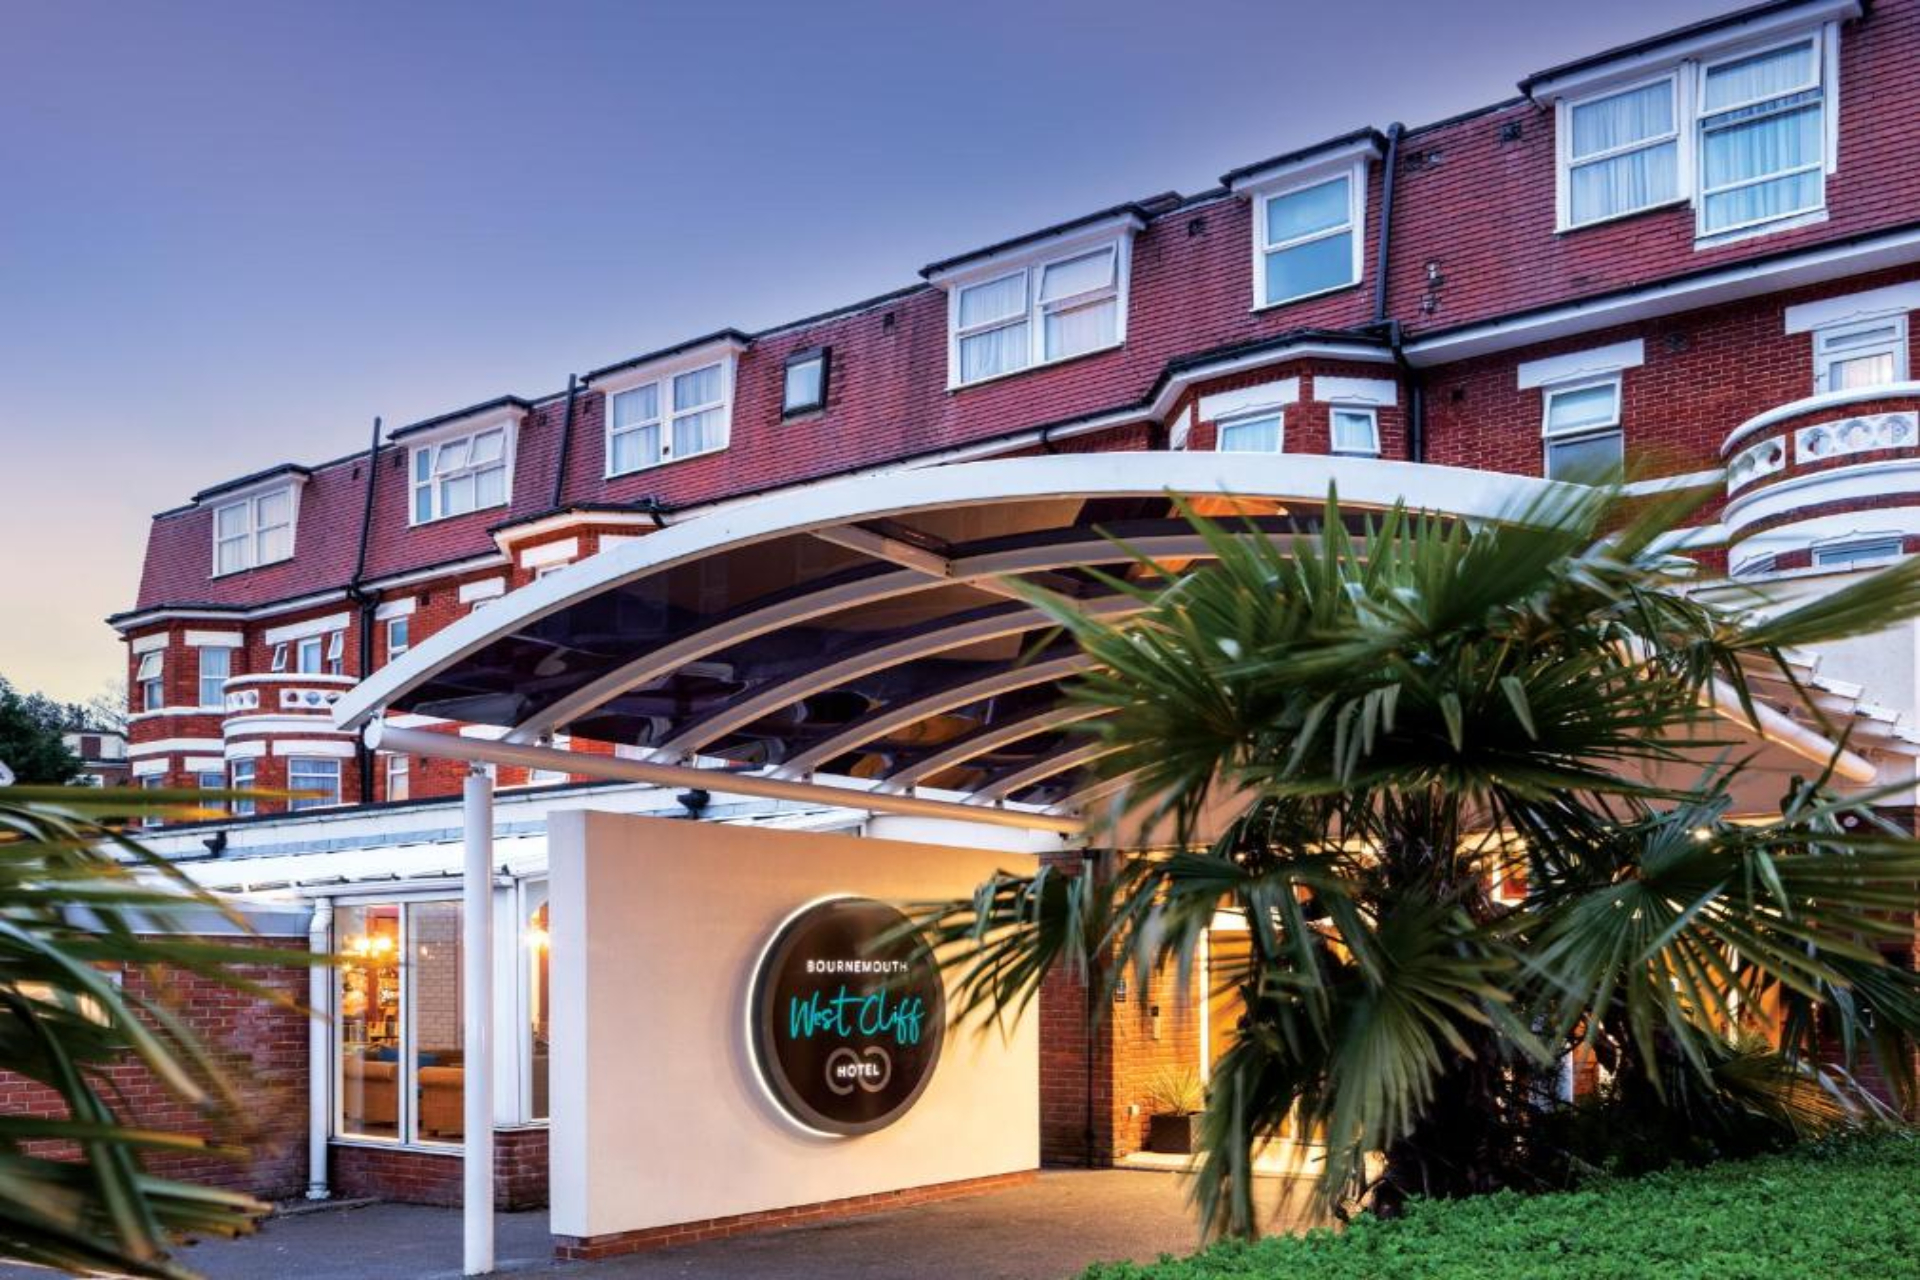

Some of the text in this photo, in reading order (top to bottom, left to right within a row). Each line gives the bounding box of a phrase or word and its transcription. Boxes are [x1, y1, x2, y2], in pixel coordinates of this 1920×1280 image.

[806, 960, 909, 973] BOURNEMOUTH
[790, 985, 925, 1044] West Cliff
[836, 1063, 880, 1078] HOTEL
